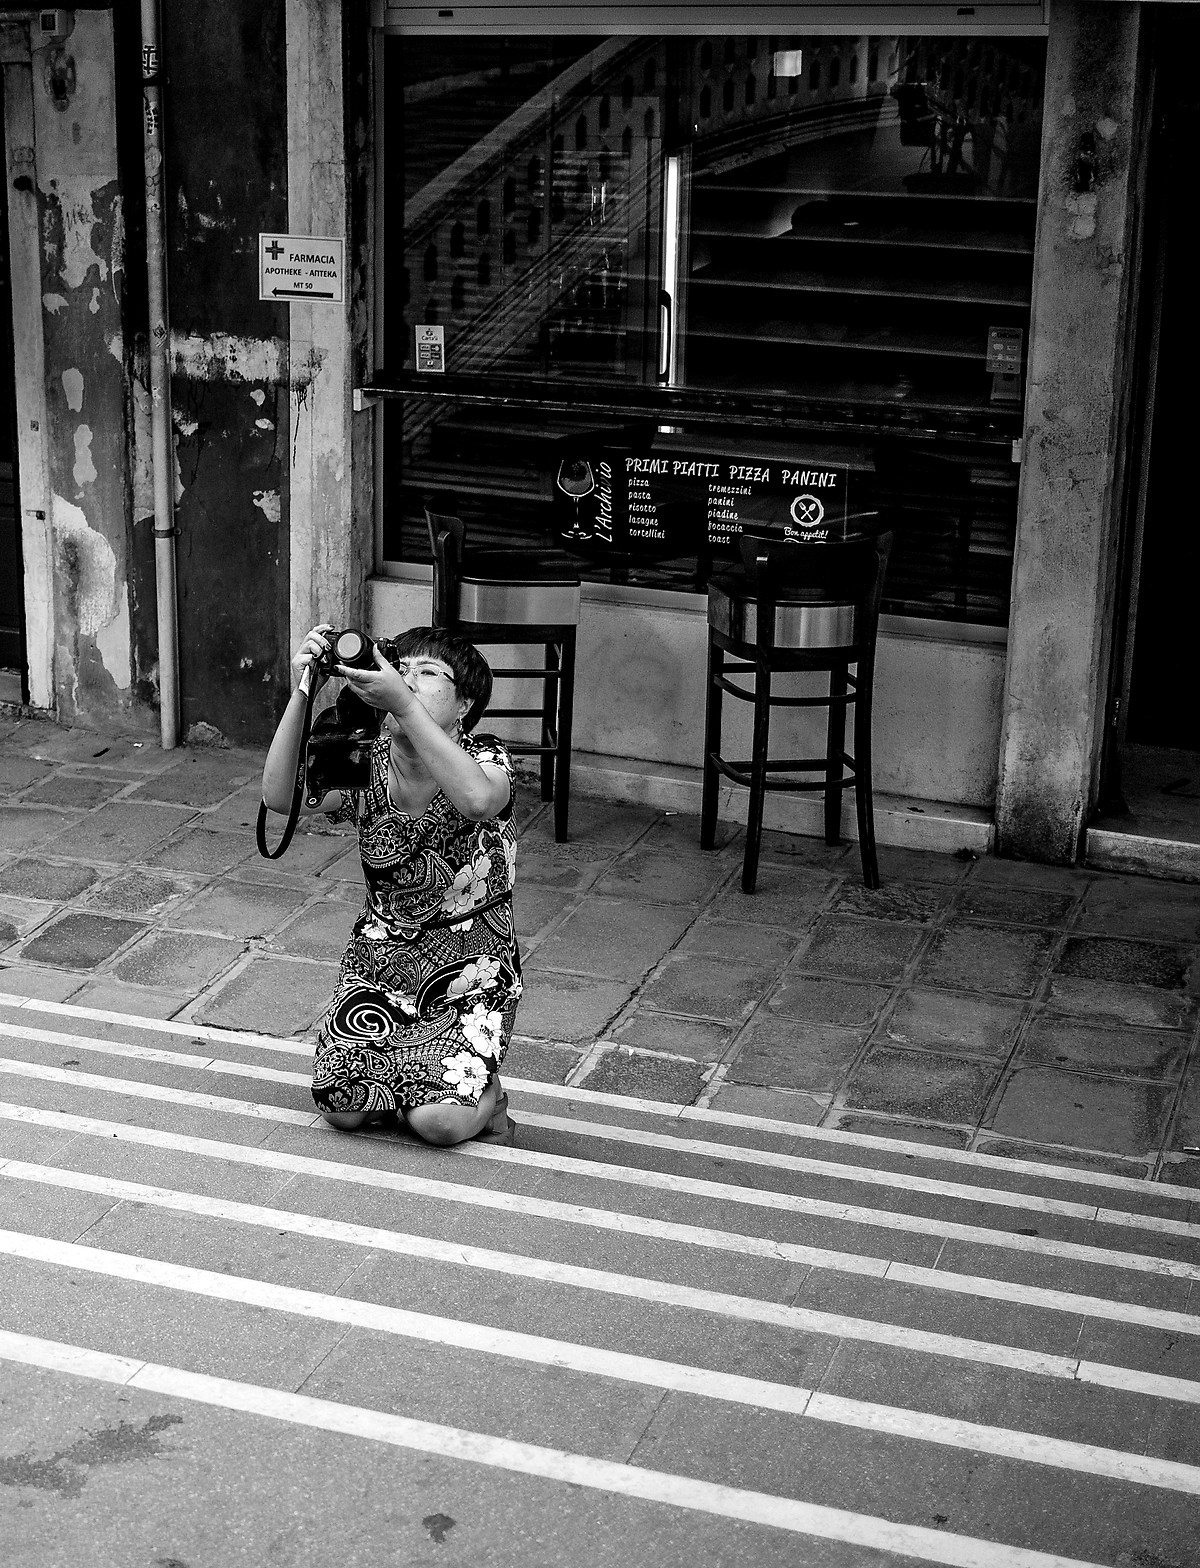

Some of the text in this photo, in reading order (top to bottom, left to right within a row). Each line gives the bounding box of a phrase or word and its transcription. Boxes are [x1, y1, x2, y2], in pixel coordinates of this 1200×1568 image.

[289, 253, 336, 265] FARMACIA
[264, 267, 302, 276] APOTHEKE
[293, 281, 314, 290] MT 50
[625, 457, 838, 488] PRIMI PIATTI PIZZA PANINI
[627, 477, 650, 488] pizza
[627, 490, 652, 500] pasta
[593, 461, 613, 543] L'Archivio
[707, 496, 735, 507] panini
[628, 503, 657, 513] risotto
[707, 509, 739, 521] piadine
[628, 515, 659, 527] lasagne
[707, 521, 744, 533] focaccia
[783, 526, 799, 536] Bon
[628, 528, 666, 540] tortellini
[708, 534, 731, 545] toast
